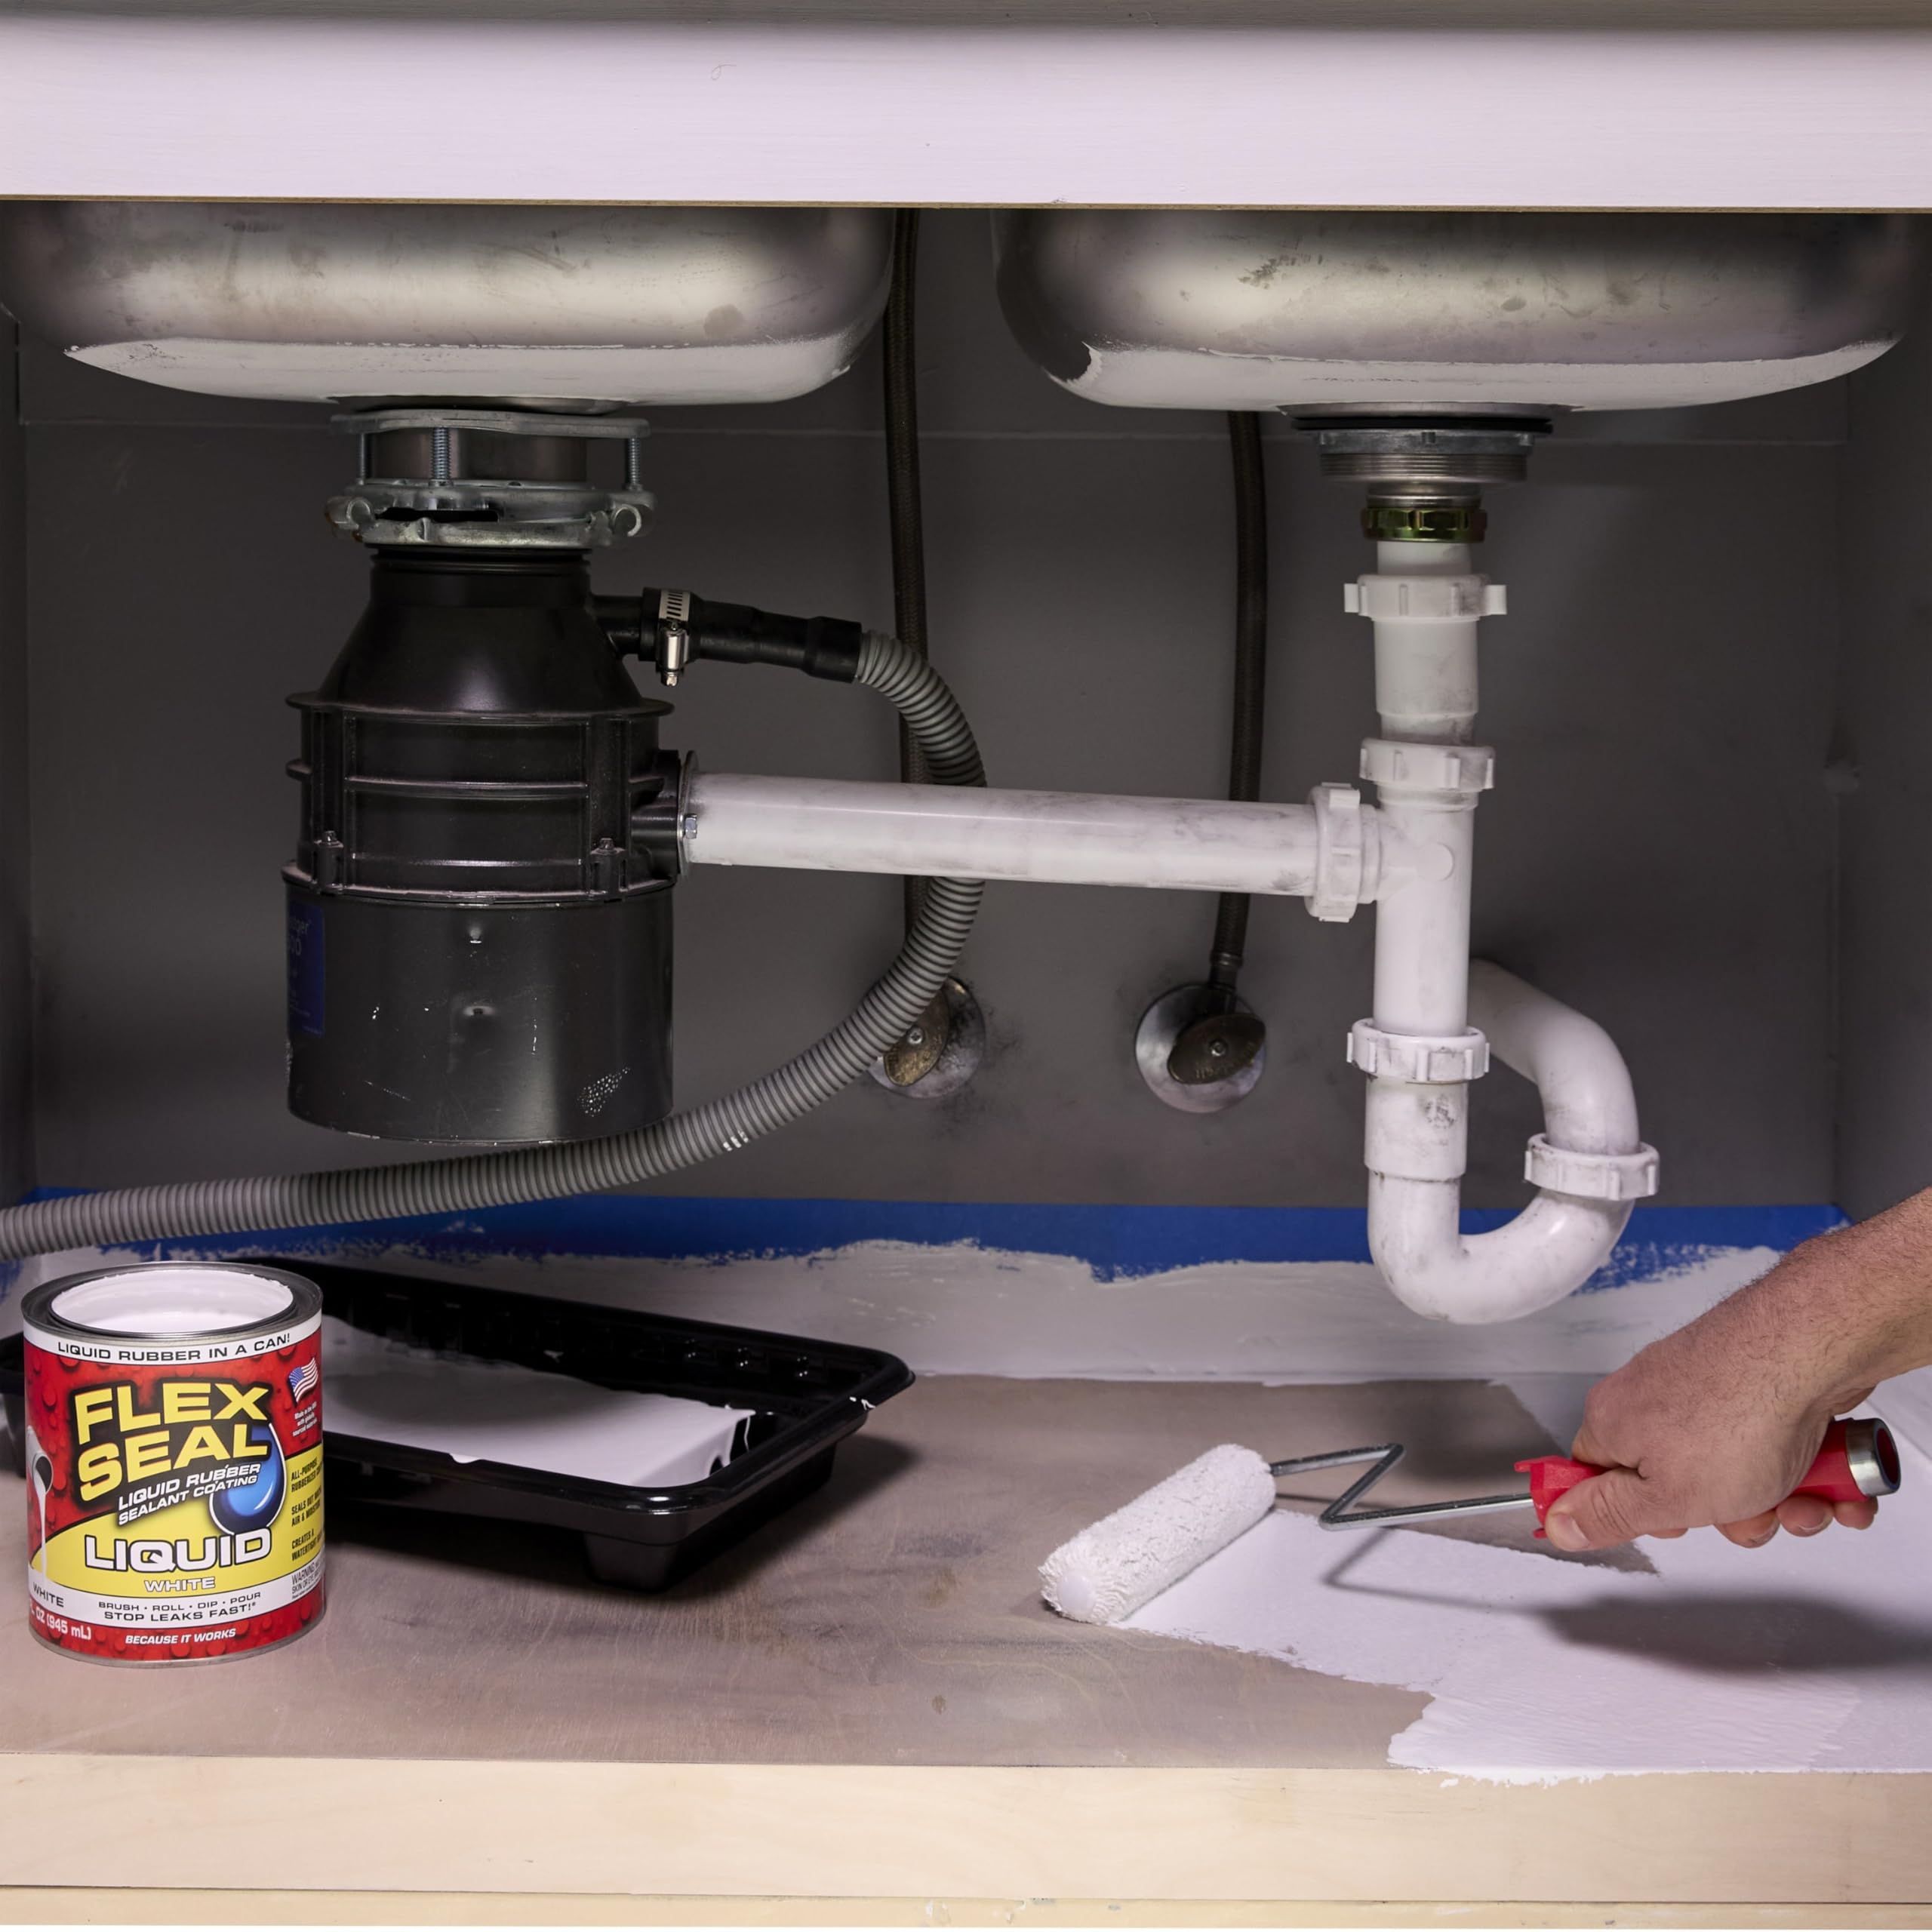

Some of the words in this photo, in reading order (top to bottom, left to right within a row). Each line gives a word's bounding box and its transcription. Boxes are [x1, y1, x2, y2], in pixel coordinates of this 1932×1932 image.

[58, 1342, 111, 1358] LIQUID
[118, 1350, 201, 1361] RUBBER
[209, 1347, 227, 1358] IN
[235, 1345, 247, 1355] A
[254, 1334, 291, 1351] CAN!
[75, 1383, 269, 1445] FLEX
[78, 1424, 268, 1502] SEAL
[118, 1478, 180, 1511] LIQUID
[186, 1463, 261, 1487] RUBBER
[118, 1490, 189, 1525] SEALANT
[193, 1475, 257, 1498] COATING
[291, 1500, 306, 1515] SEALS
[291, 1515, 300, 1527] AIR
[85, 1527, 272, 1573] LIQUID
[291, 1531, 311, 1549] CREATES
[33, 1582, 64, 1607] WHITE
[144, 1577, 215, 1592] WHITE
[98, 1601, 139, 1611] BRUSH
[198, 1601, 218, 1609] DIP
[230, 1592, 261, 1604] POUR
[35, 1605, 45, 1624] OZ
[47, 1613, 68, 1634] (945
[71, 1625, 91, 1640] mL)
[104, 1611, 144, 1622] STOP
[150, 1611, 203, 1622] LEAKS
[125, 1634, 178, 1644] BECAUSE
[180, 1635, 190, 1644] IT
[193, 1628, 236, 1643] WORKS
